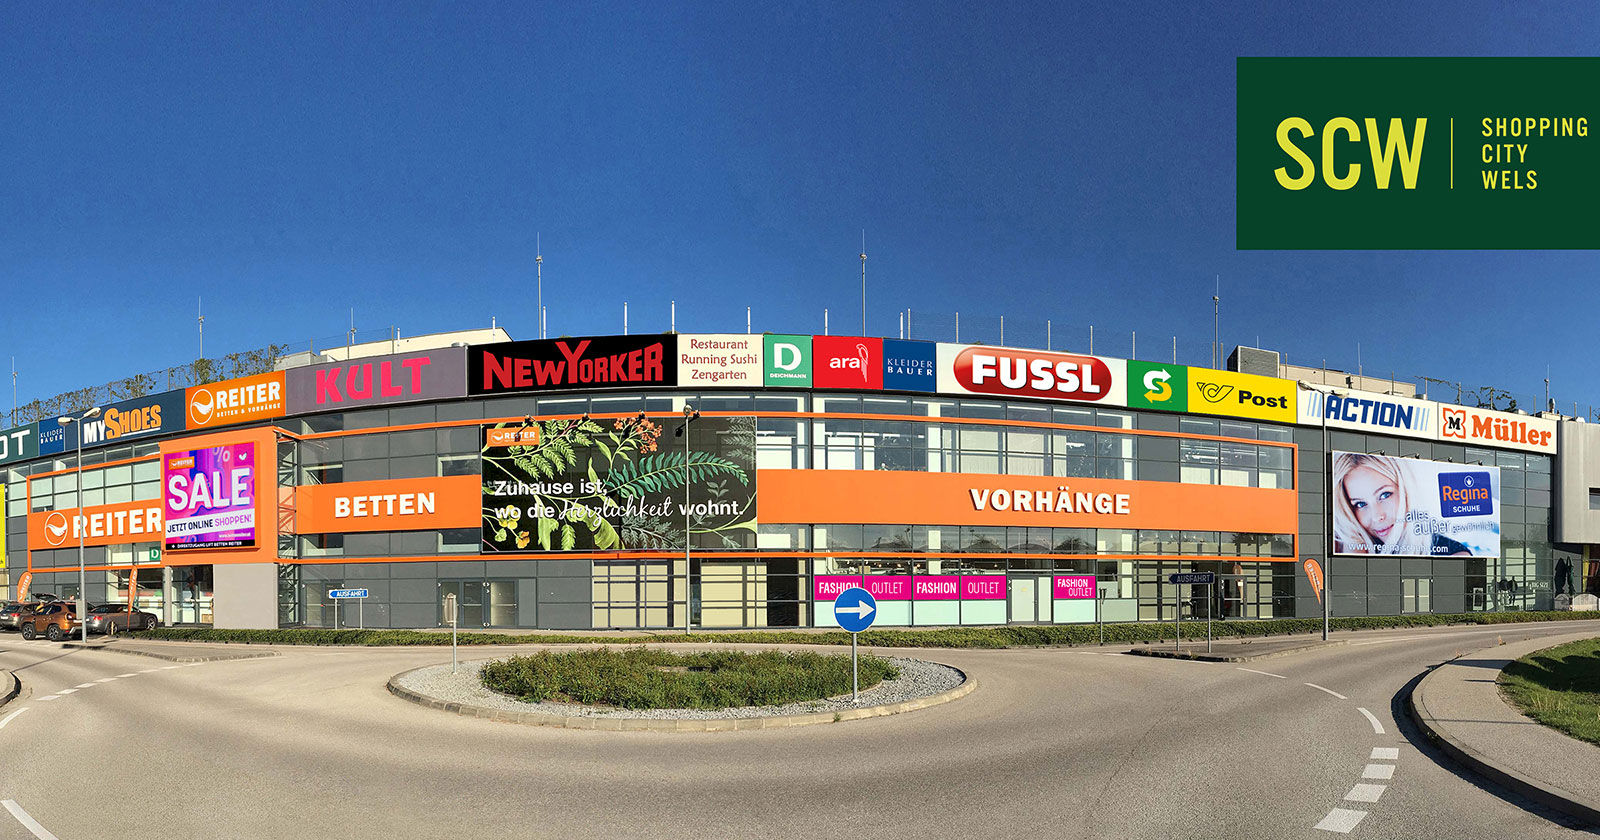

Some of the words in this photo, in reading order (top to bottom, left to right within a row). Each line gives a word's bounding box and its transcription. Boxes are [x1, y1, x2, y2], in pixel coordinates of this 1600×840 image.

[690, 338, 749, 350] Restaurant
[681, 354, 727, 367] Running
[730, 354, 758, 365] Sushi
[829, 355, 860, 369] ara
[887, 357, 933, 369] KLEIDER
[315, 356, 432, 405] KULT
[691, 369, 748, 383] Zengarten
[887, 366, 933, 377] BAUER
[972, 354, 1101, 394] FUSSL
[216, 381, 281, 409] REITER
[1238, 389, 1288, 409] Post
[1325, 394, 1414, 430] ACTION
[40, 428, 63, 438] KLEIDER
[40, 434, 63, 445] BAUER
[1471, 414, 1552, 447] Müller
[168, 468, 250, 511] SALE
[494, 480, 574, 497] Zuhause
[580, 478, 608, 496] ist,
[1442, 485, 1489, 505] Regina
[334, 491, 436, 518] BETTEN
[968, 486, 1131, 514] VORHÄNGE
[1452, 504, 1481, 513] SCHUHE
[494, 507, 522, 519] wo
[527, 503, 555, 519] die
[558, 493, 674, 527] Herzlichkeit
[678, 500, 744, 516] wohnt.
[72, 507, 162, 539] REITER
[167, 522, 187, 534] JETZT
[188, 519, 214, 531] ONLINE
[214, 513, 253, 527] SHOPPEN!
[1414, 516, 1450, 536] außer
[871, 581, 904, 594] OUTLET
[916, 582, 957, 594] FASHION
[967, 581, 1000, 594] OUTLET
[1057, 578, 1089, 588] FASHION
[1176, 574, 1211, 583] AUSFAHRT
[1068, 587, 1093, 597] OUTLET
